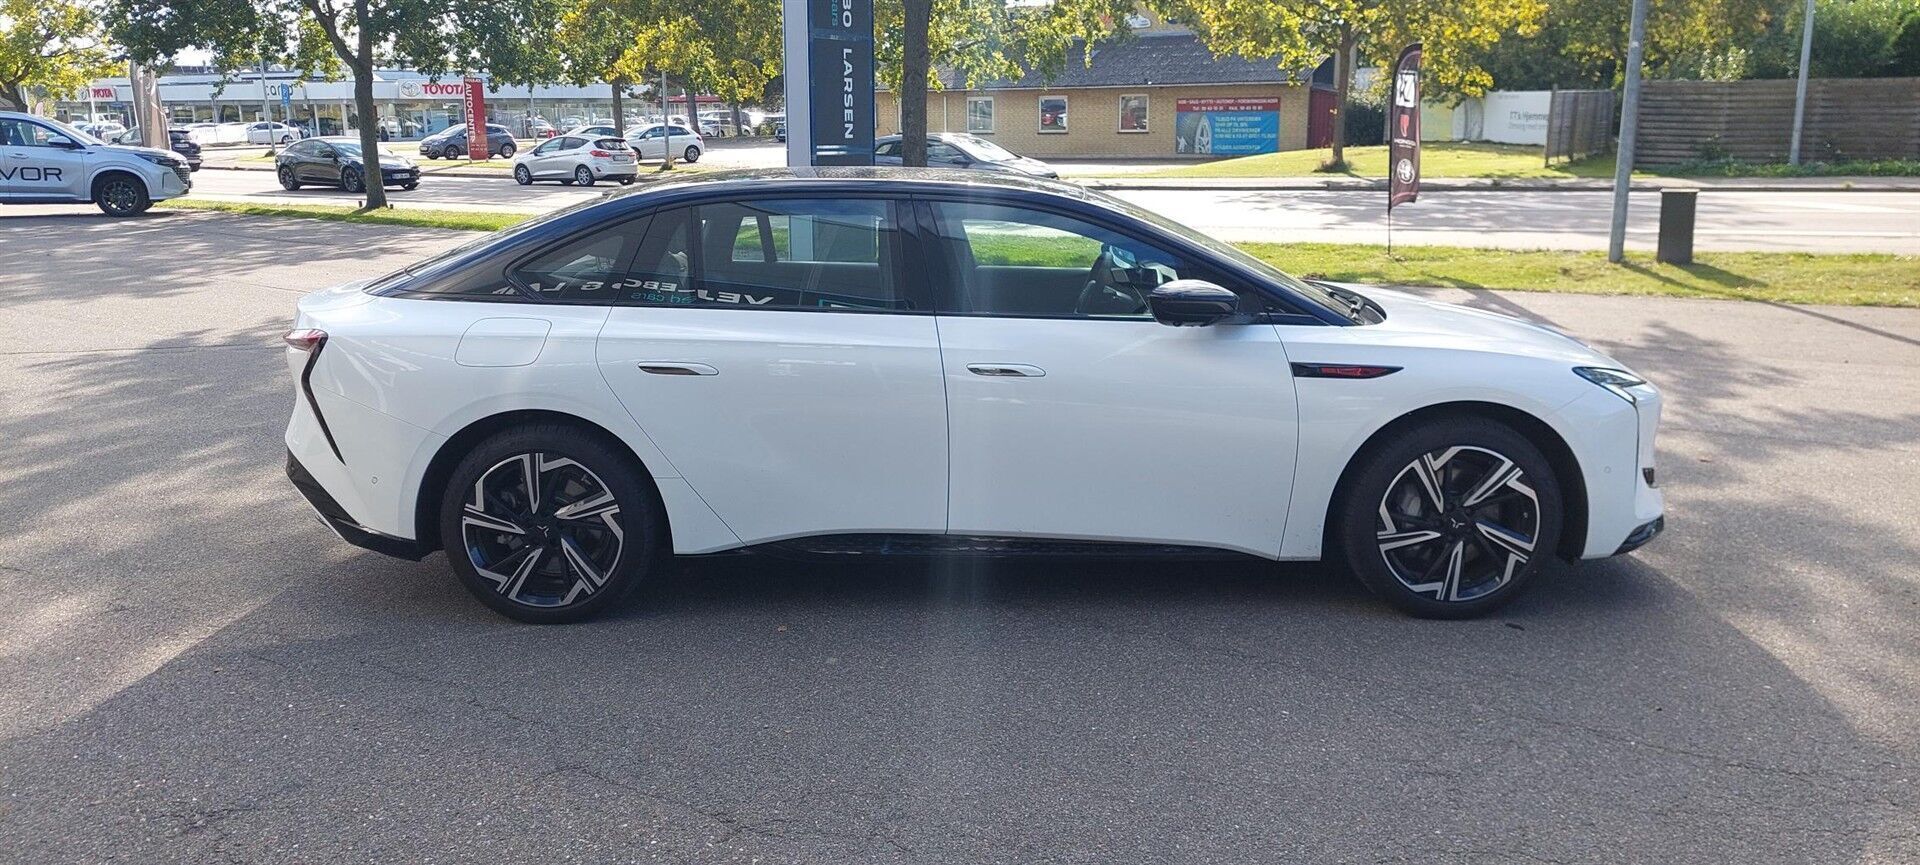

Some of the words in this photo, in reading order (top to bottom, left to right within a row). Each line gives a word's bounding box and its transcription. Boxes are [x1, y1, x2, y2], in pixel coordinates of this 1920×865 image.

[87, 88, 113, 98] TYOTA
[465, 83, 476, 143] AUTOCENTER
[843, 48, 854, 139] LARSEN
